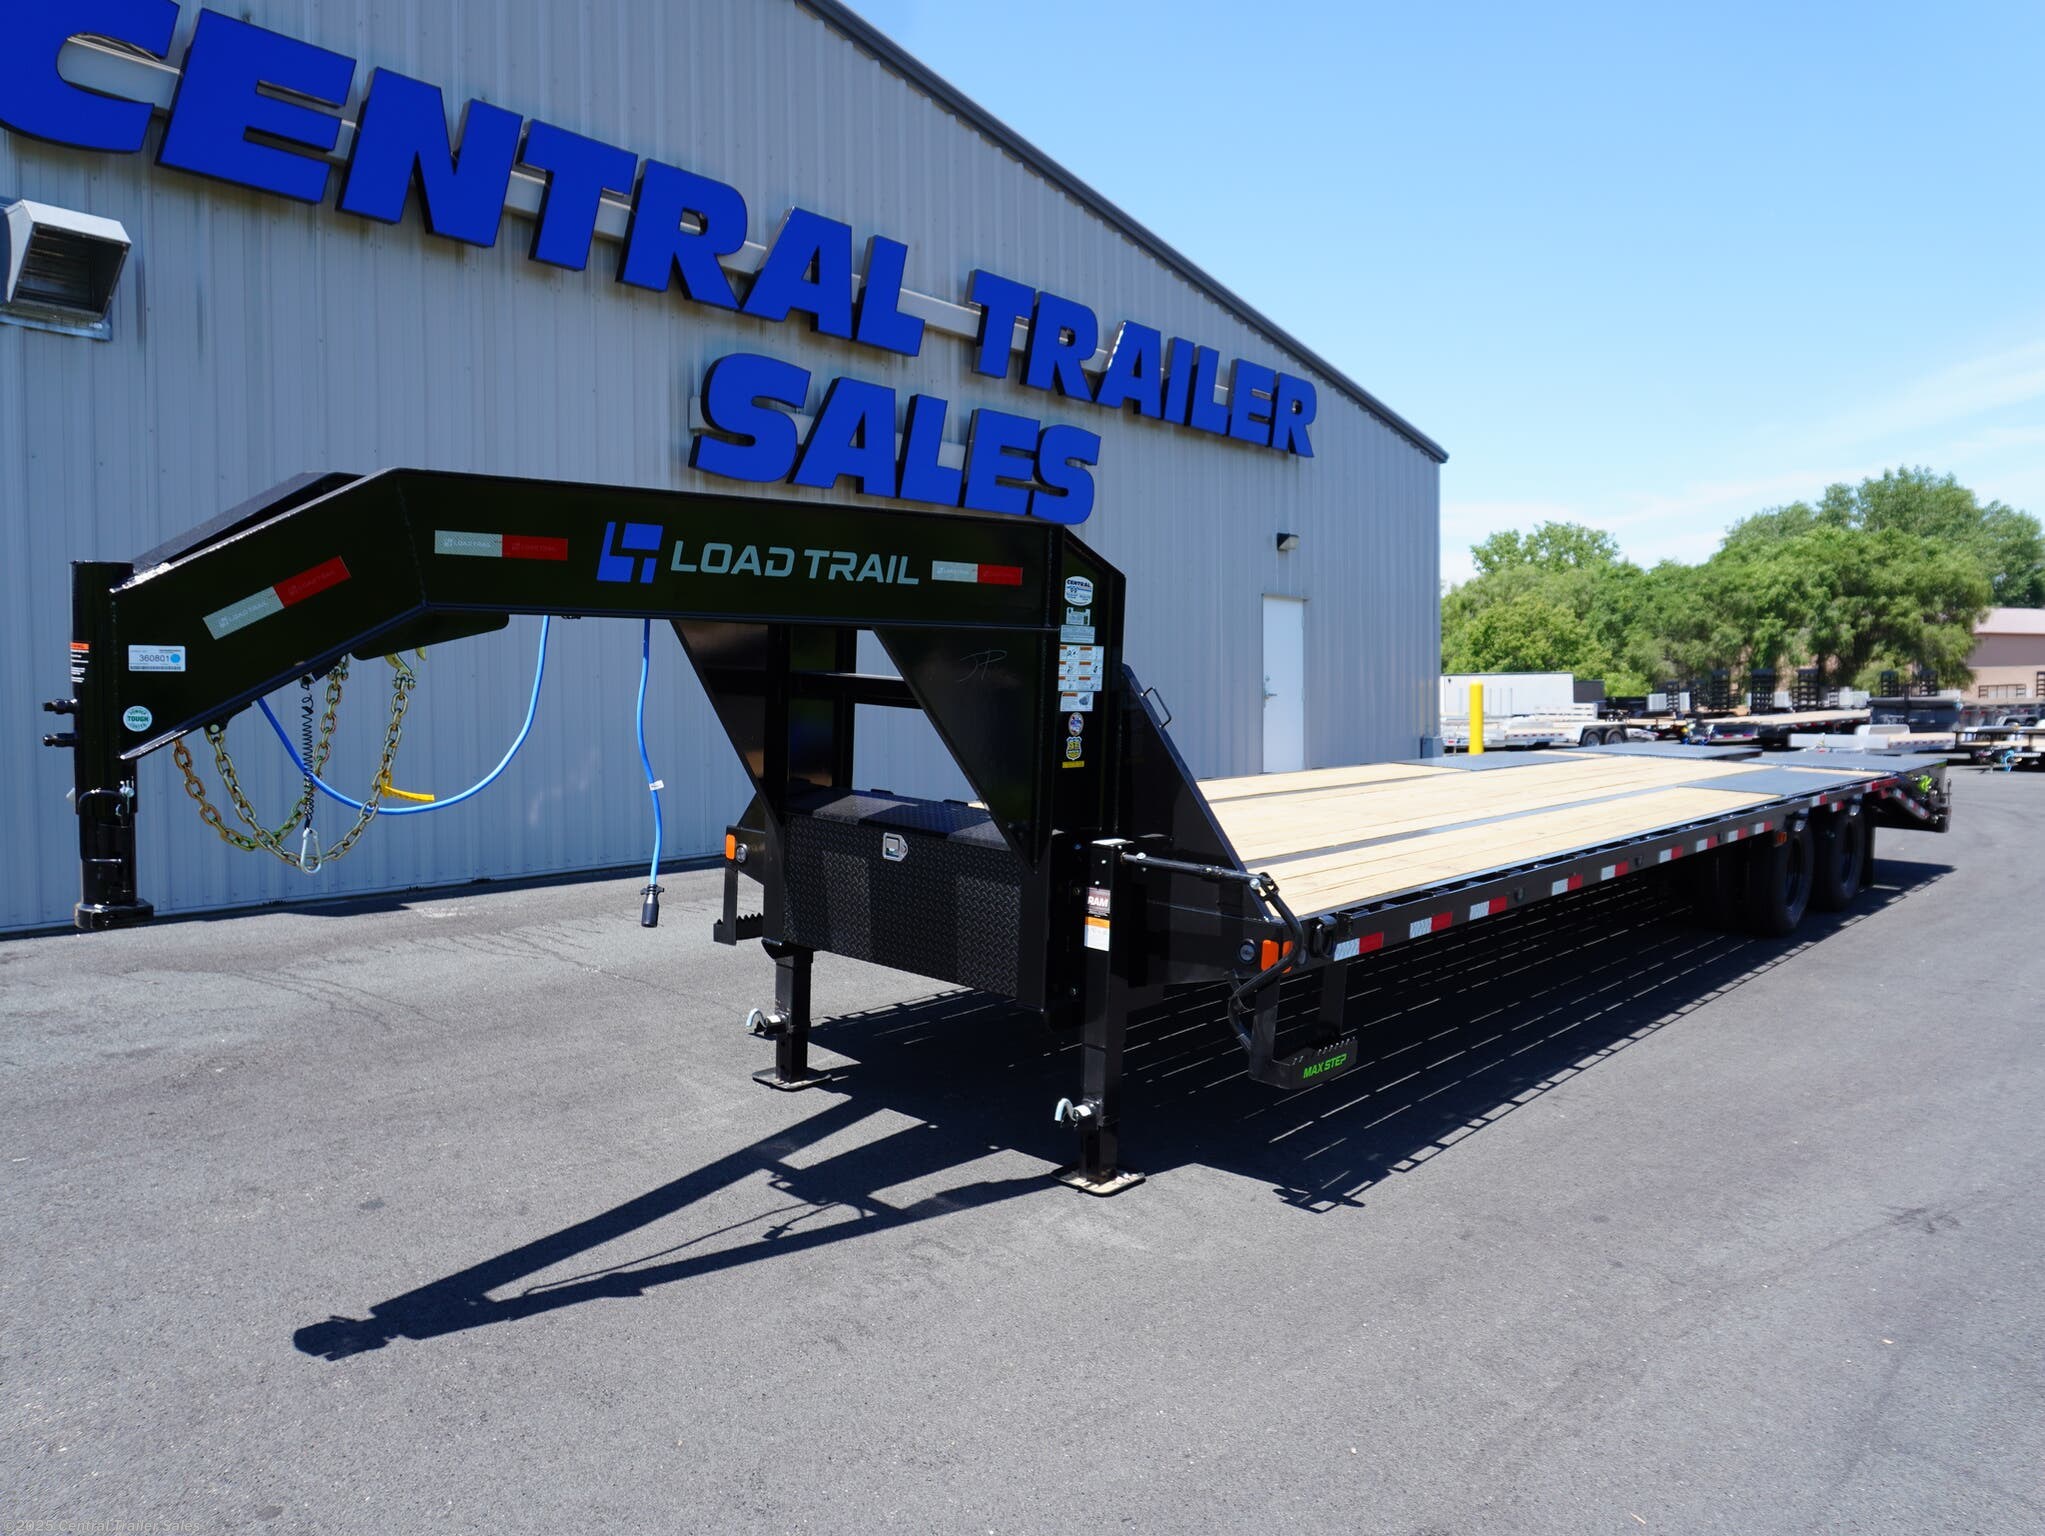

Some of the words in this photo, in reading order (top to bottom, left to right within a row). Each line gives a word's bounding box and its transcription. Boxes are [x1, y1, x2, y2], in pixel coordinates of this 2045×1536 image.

[0, 0, 925, 356] CENTRAL
[971, 269, 1317, 458] TRAILER
[694, 353, 1101, 525] SALES
[670, 540, 796, 578] LOAD
[803, 548, 920, 585] TRAIL
[138, 654, 170, 663] 360801
[1303, 1062, 1325, 1079] MAX
[1323, 1053, 1348, 1071] STEP
